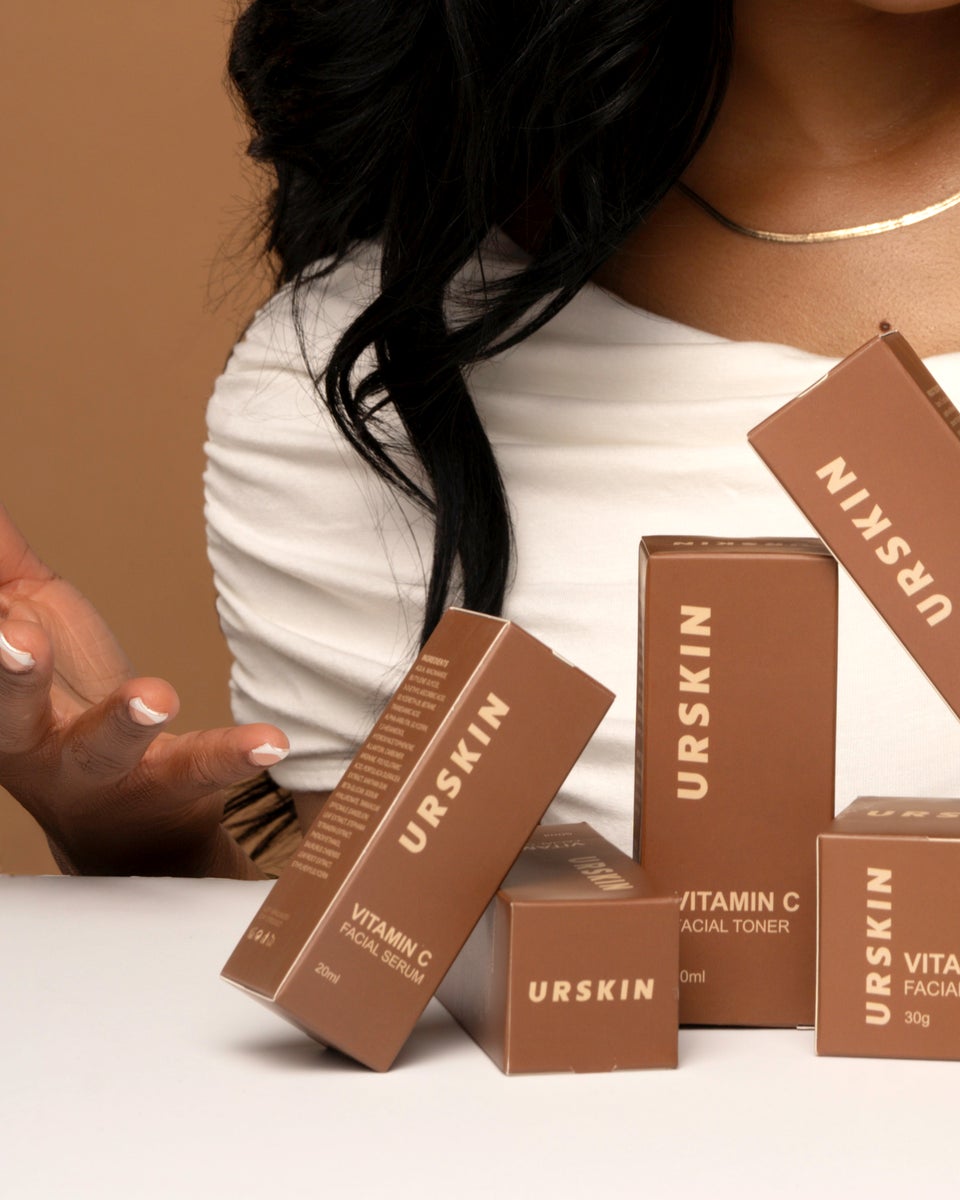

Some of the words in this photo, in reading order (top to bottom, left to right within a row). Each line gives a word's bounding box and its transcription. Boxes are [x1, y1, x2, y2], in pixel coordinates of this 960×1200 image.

[815, 455, 954, 628] URSKIN
[677, 604, 712, 800] URSKIN
[398, 692, 511, 855] URSKIN
[680, 919, 728, 933] ACIAL
[733, 919, 790, 934] TONER
[783, 891, 800, 912] C
[340, 921, 379, 957] FACIAL
[381, 950, 425, 985] SERUM
[352, 902, 418, 958] VITAMIN
[417, 950, 433, 967] C
[865, 866, 893, 1026] URSKIN
[314, 961, 340, 984] 20ml
[528, 978, 654, 1004] URSKIN
[904, 1010, 930, 1028] 30g
